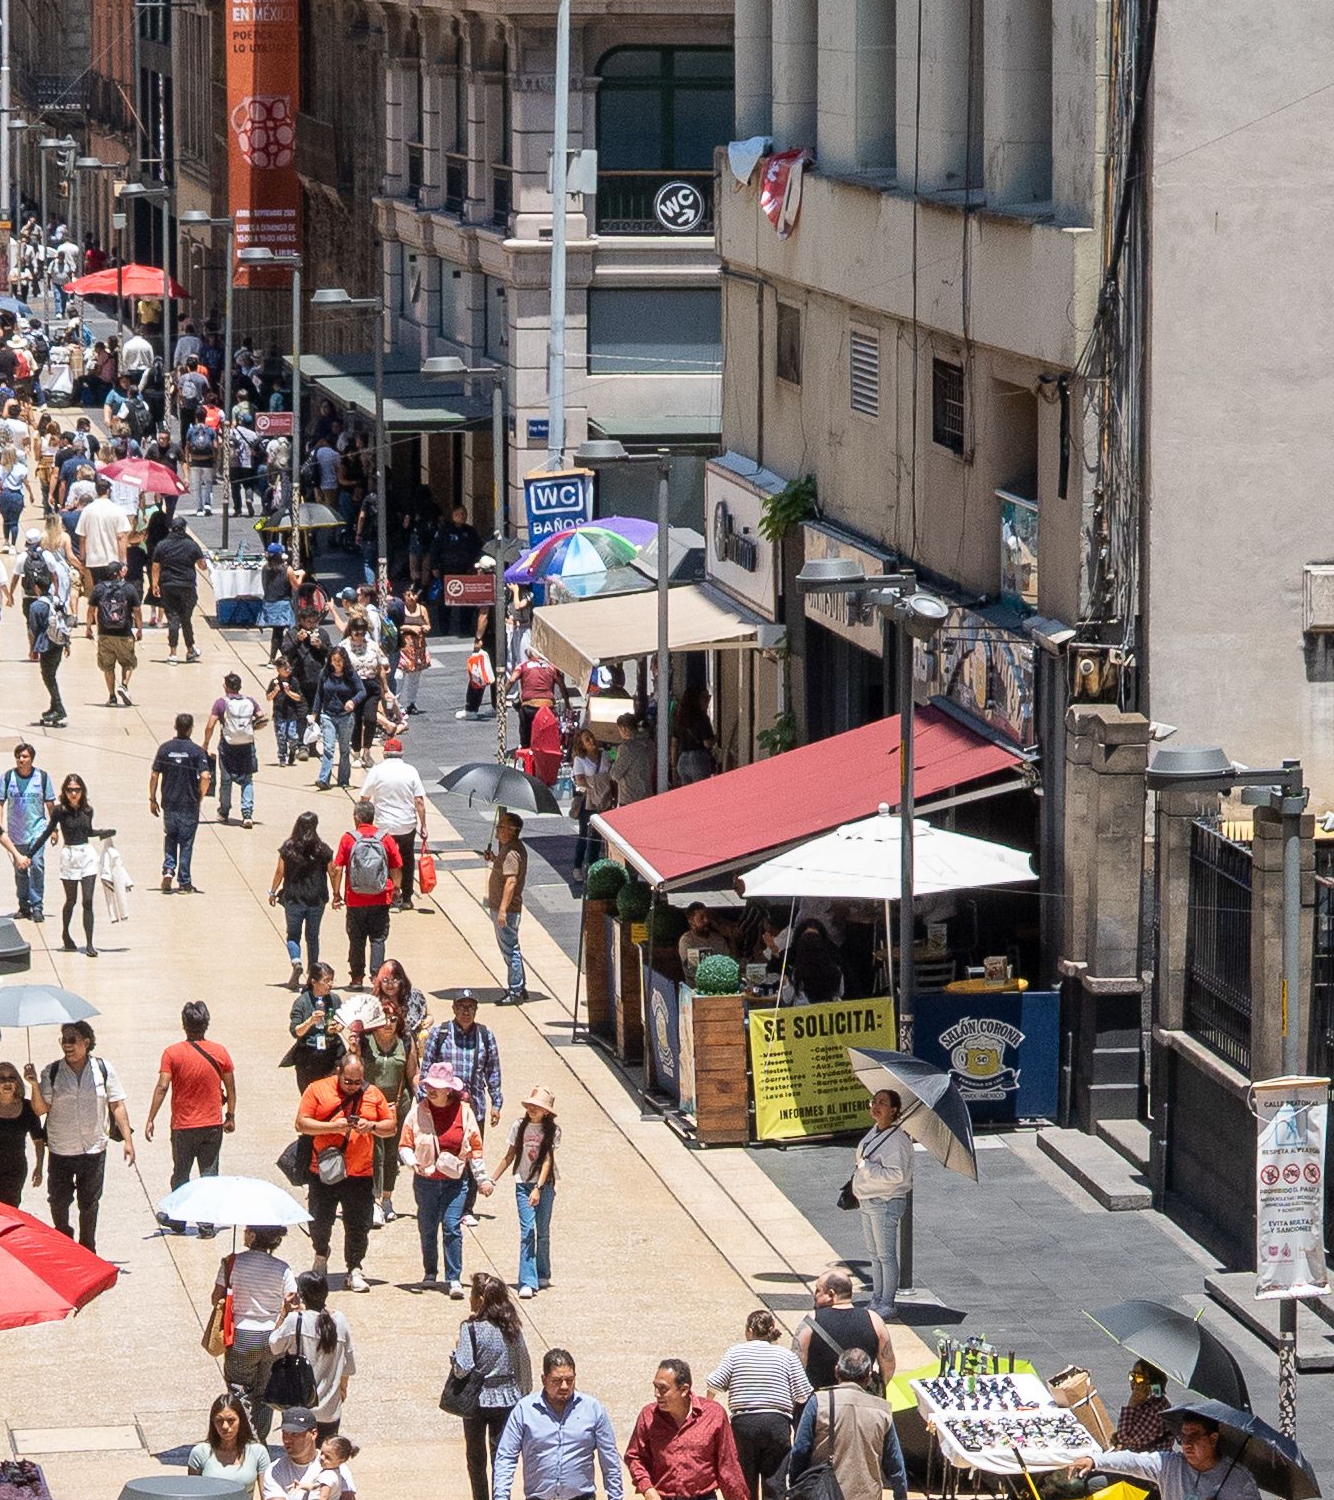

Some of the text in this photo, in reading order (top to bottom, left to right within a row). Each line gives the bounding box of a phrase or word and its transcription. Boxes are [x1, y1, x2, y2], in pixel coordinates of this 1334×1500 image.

[232, 4, 295, 22] EN MÉXICO
[660, 189, 694, 217] WC
[537, 485, 576, 507] WC
[763, 1010, 883, 1043] SE SOLICITA:
[940, 1018, 1022, 1048] SALÓN CORONA
[780, 1105, 824, 1120] INFORMES
[827, 1105, 836, 1114] AL
